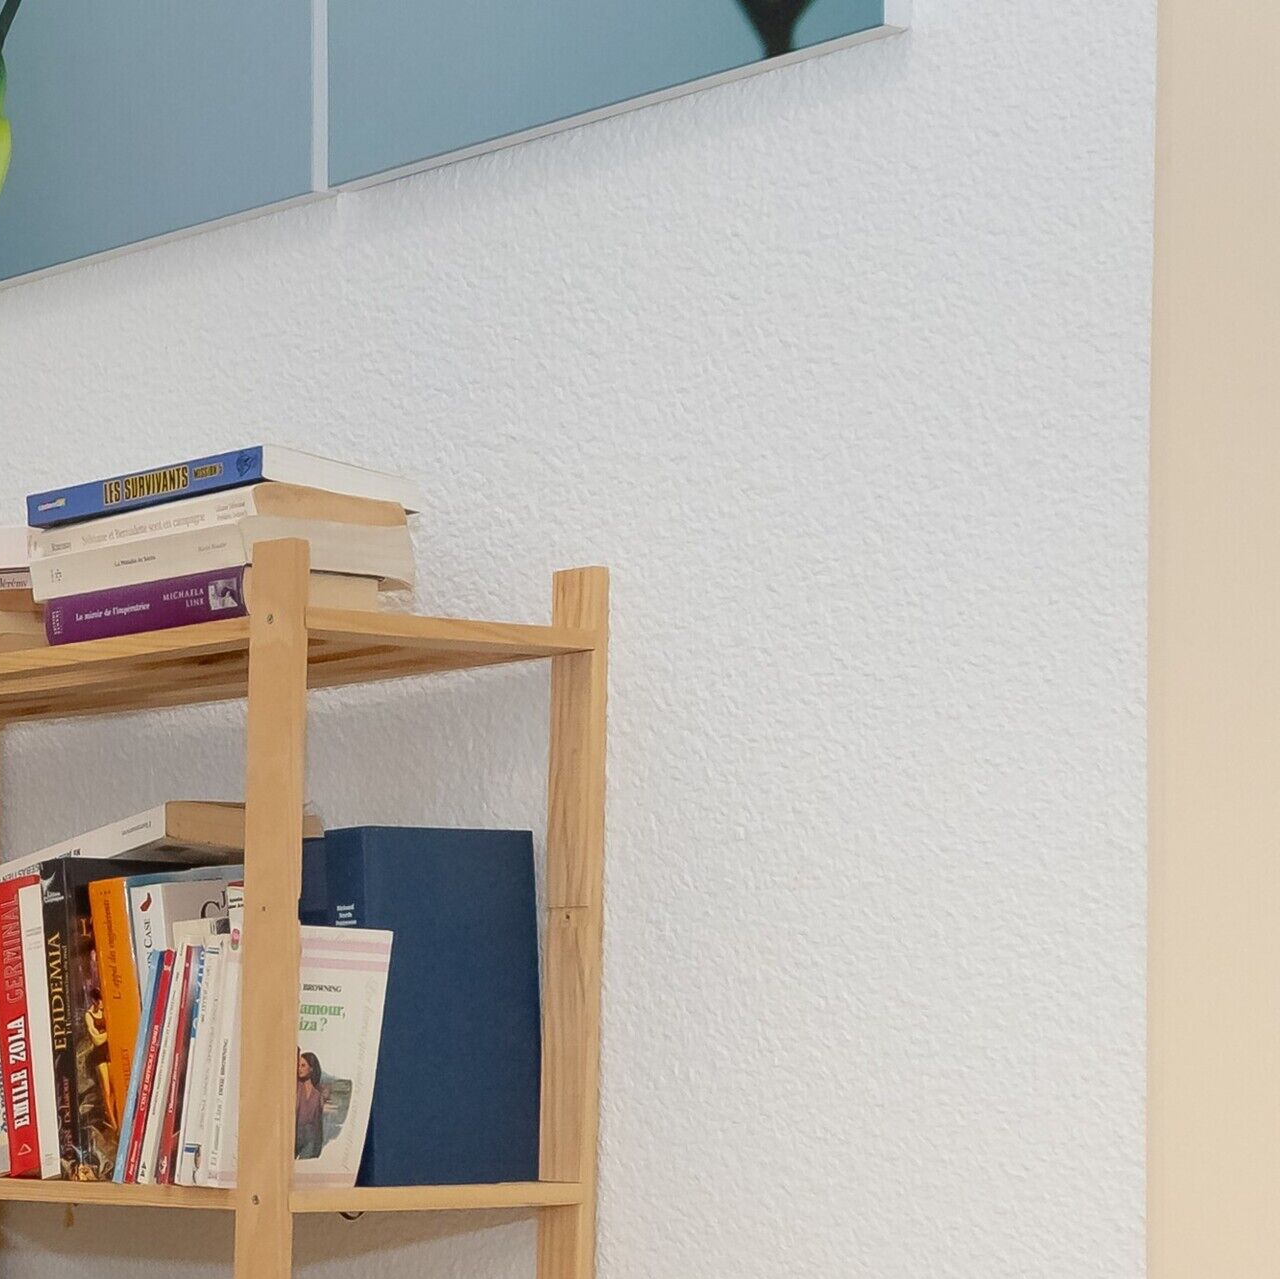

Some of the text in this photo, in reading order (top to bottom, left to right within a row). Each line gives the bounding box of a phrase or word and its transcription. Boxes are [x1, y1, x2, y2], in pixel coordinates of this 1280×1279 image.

[104, 466, 188, 504] LES SURVIVANTS
[76, 613, 84, 621] Le
[0, 895, 23, 1004] GERMINAL
[143, 918, 152, 948] CASE
[48, 932, 67, 1050] EPIDEMIA
[303, 984, 341, 992] BROWNING
[7, 1017, 30, 1128] EMILE ZOLA
